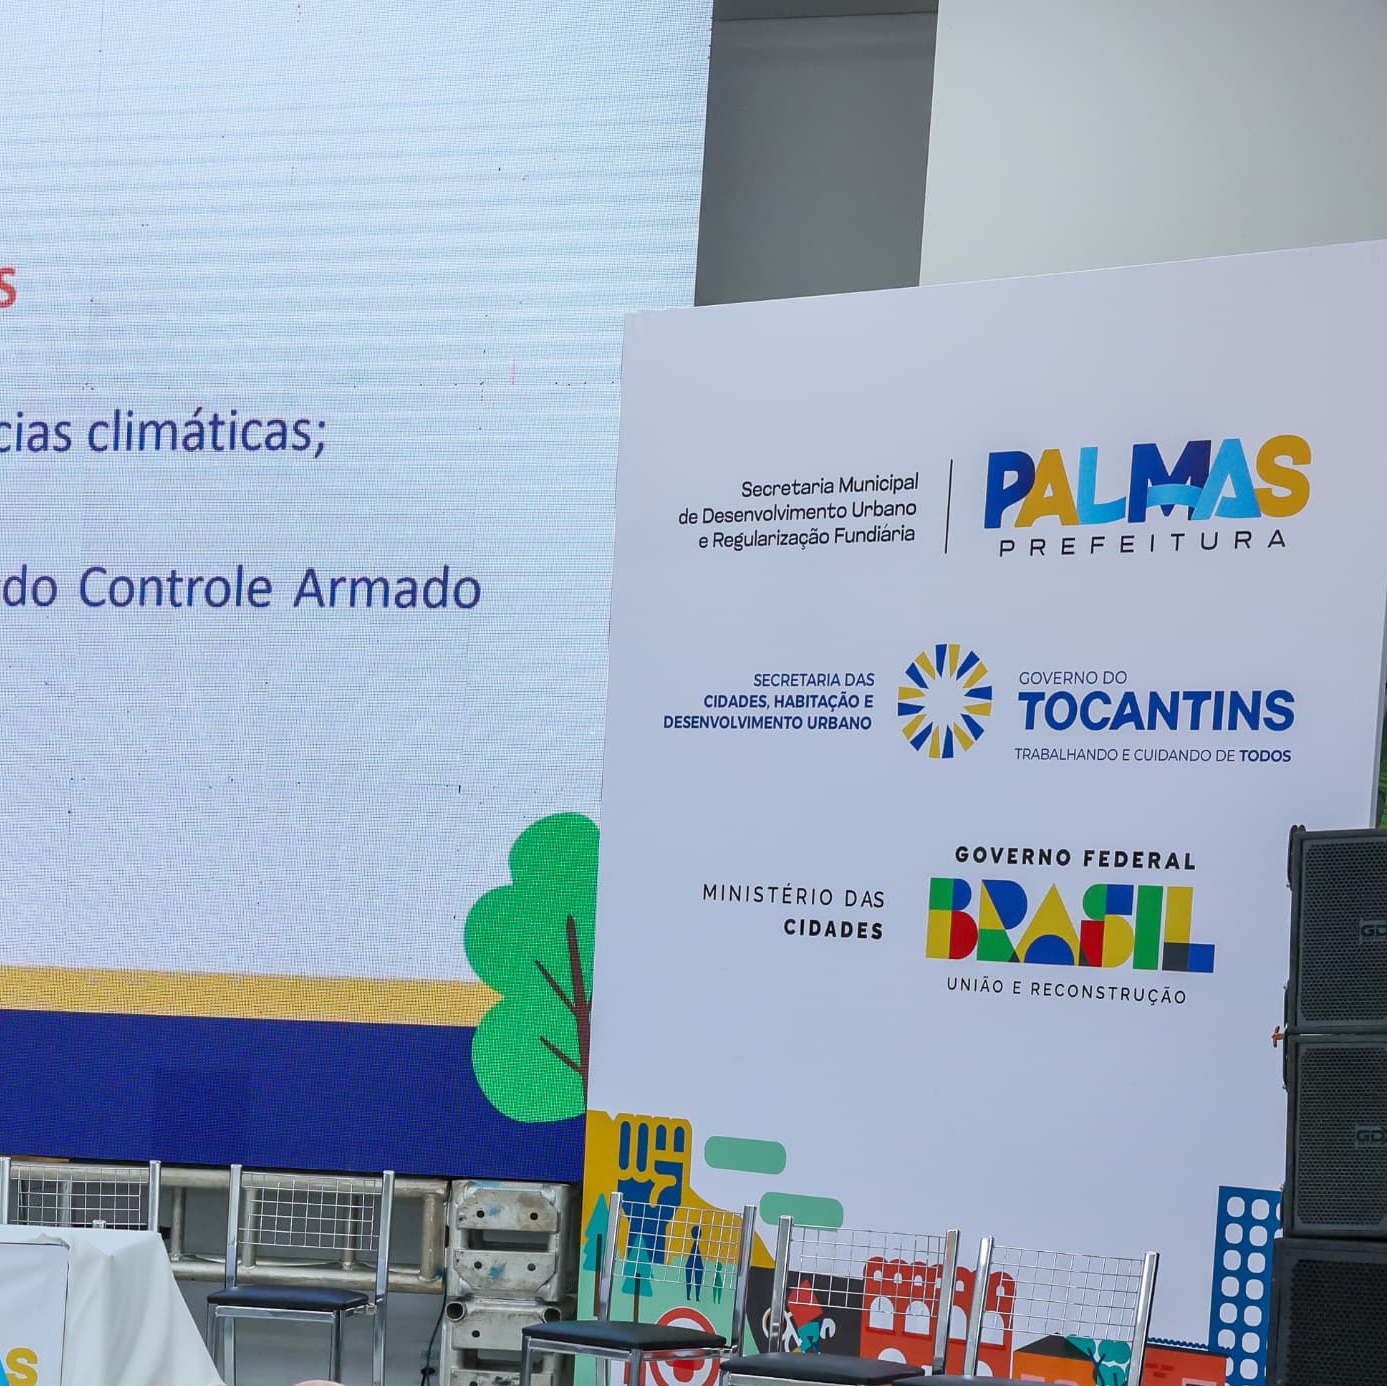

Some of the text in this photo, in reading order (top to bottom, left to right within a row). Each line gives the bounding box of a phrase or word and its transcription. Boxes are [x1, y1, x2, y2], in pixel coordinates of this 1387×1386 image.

[88, 406, 326, 458] climáticas;
[742, 472, 919, 497] Secretaria Municipal
[984, 434, 1312, 529] PALMAS
[679, 500, 917, 524] de Desenvolvimento Urbano
[699, 524, 915, 551] e Regularização Fundiária
[1000, 529, 1286, 557] PREFEITURA
[2, 564, 57, 607] do
[79, 565, 273, 608] Controle
[293, 565, 482, 609] Armado
[754, 673, 875, 687] SECRETARIA DAS
[1019, 671, 1127, 685] GOVERNO DO
[704, 691, 873, 712] CIDADES, HABITAÇÃO E
[1018, 690, 1295, 731] TOCANTINS
[663, 715, 872, 730] DESENVOLVIMENTO URBANO
[1015, 748, 1291, 762] TRABALHANDO E CUIDANDO DE TODOS
[955, 846, 1196, 870] GOVERNO FEDERAL
[702, 883, 884, 908] MINISTÉRIO DAS
[784, 918, 883, 939] CIDADES
[926, 877, 1215, 973] BRASIL
[947, 976, 1186, 1006] UNIÃO E RECONSTRUÇÃO
